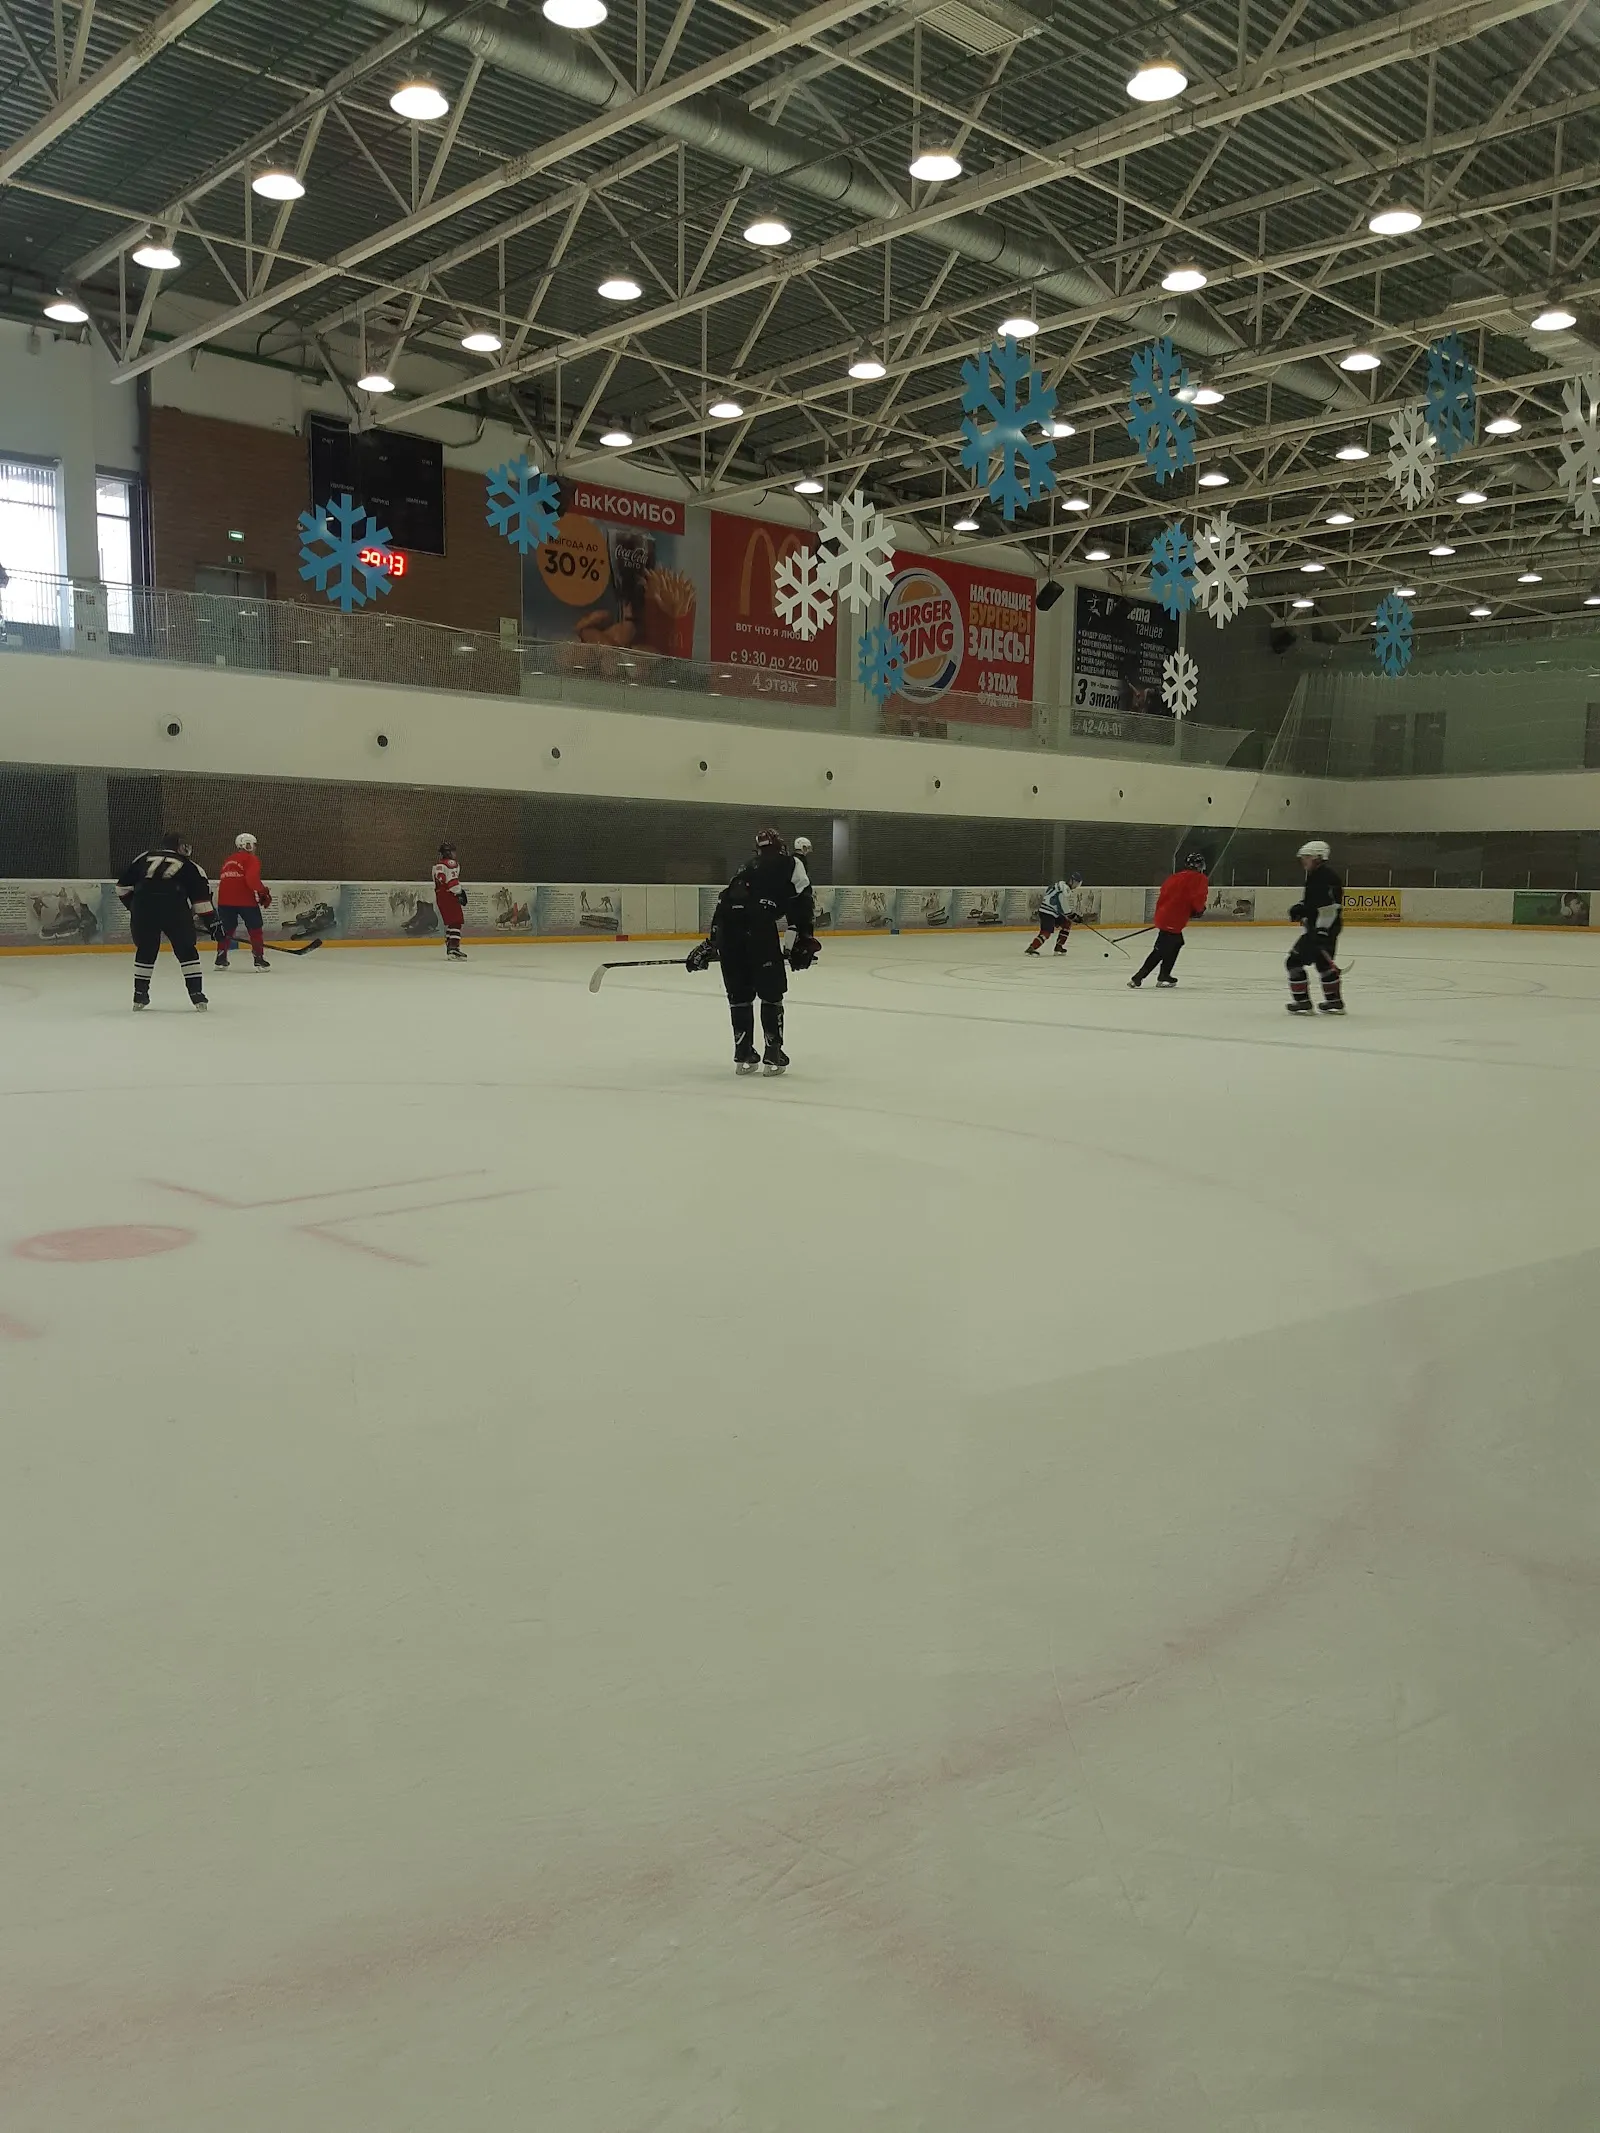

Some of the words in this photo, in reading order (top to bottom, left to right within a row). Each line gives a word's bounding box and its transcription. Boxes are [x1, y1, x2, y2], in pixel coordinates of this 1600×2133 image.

[586, 543, 599, 551] ДО
[970, 584, 1032, 612] НАСТОЯЩИЕ
[888, 599, 952, 635] BURGER
[969, 602, 1031, 635] БУРГЕРЫ
[735, 622, 753, 632] вот
[754, 625, 771, 636] что
[773, 628, 779, 637] я
[781, 629, 815, 642] любю
[1135, 623, 1163, 638] танцев
[968, 625, 1031, 664] ЗДЕСЬ!
[730, 651, 738, 662] с
[741, 648, 766, 666] 9:30
[769, 656, 785, 670] до
[788, 655, 819, 673] 22:00
[752, 672, 760, 689] 4
[765, 678, 799, 694] этаж
[978, 671, 986, 690] 4
[988, 671, 1018, 694] ЭТАЖ
[1076, 679, 1088, 704] 3
[1089, 688, 1121, 710] этаж
[144, 856, 184, 879] 77
[1343, 895, 1397, 907] ГОЛОЧКА
